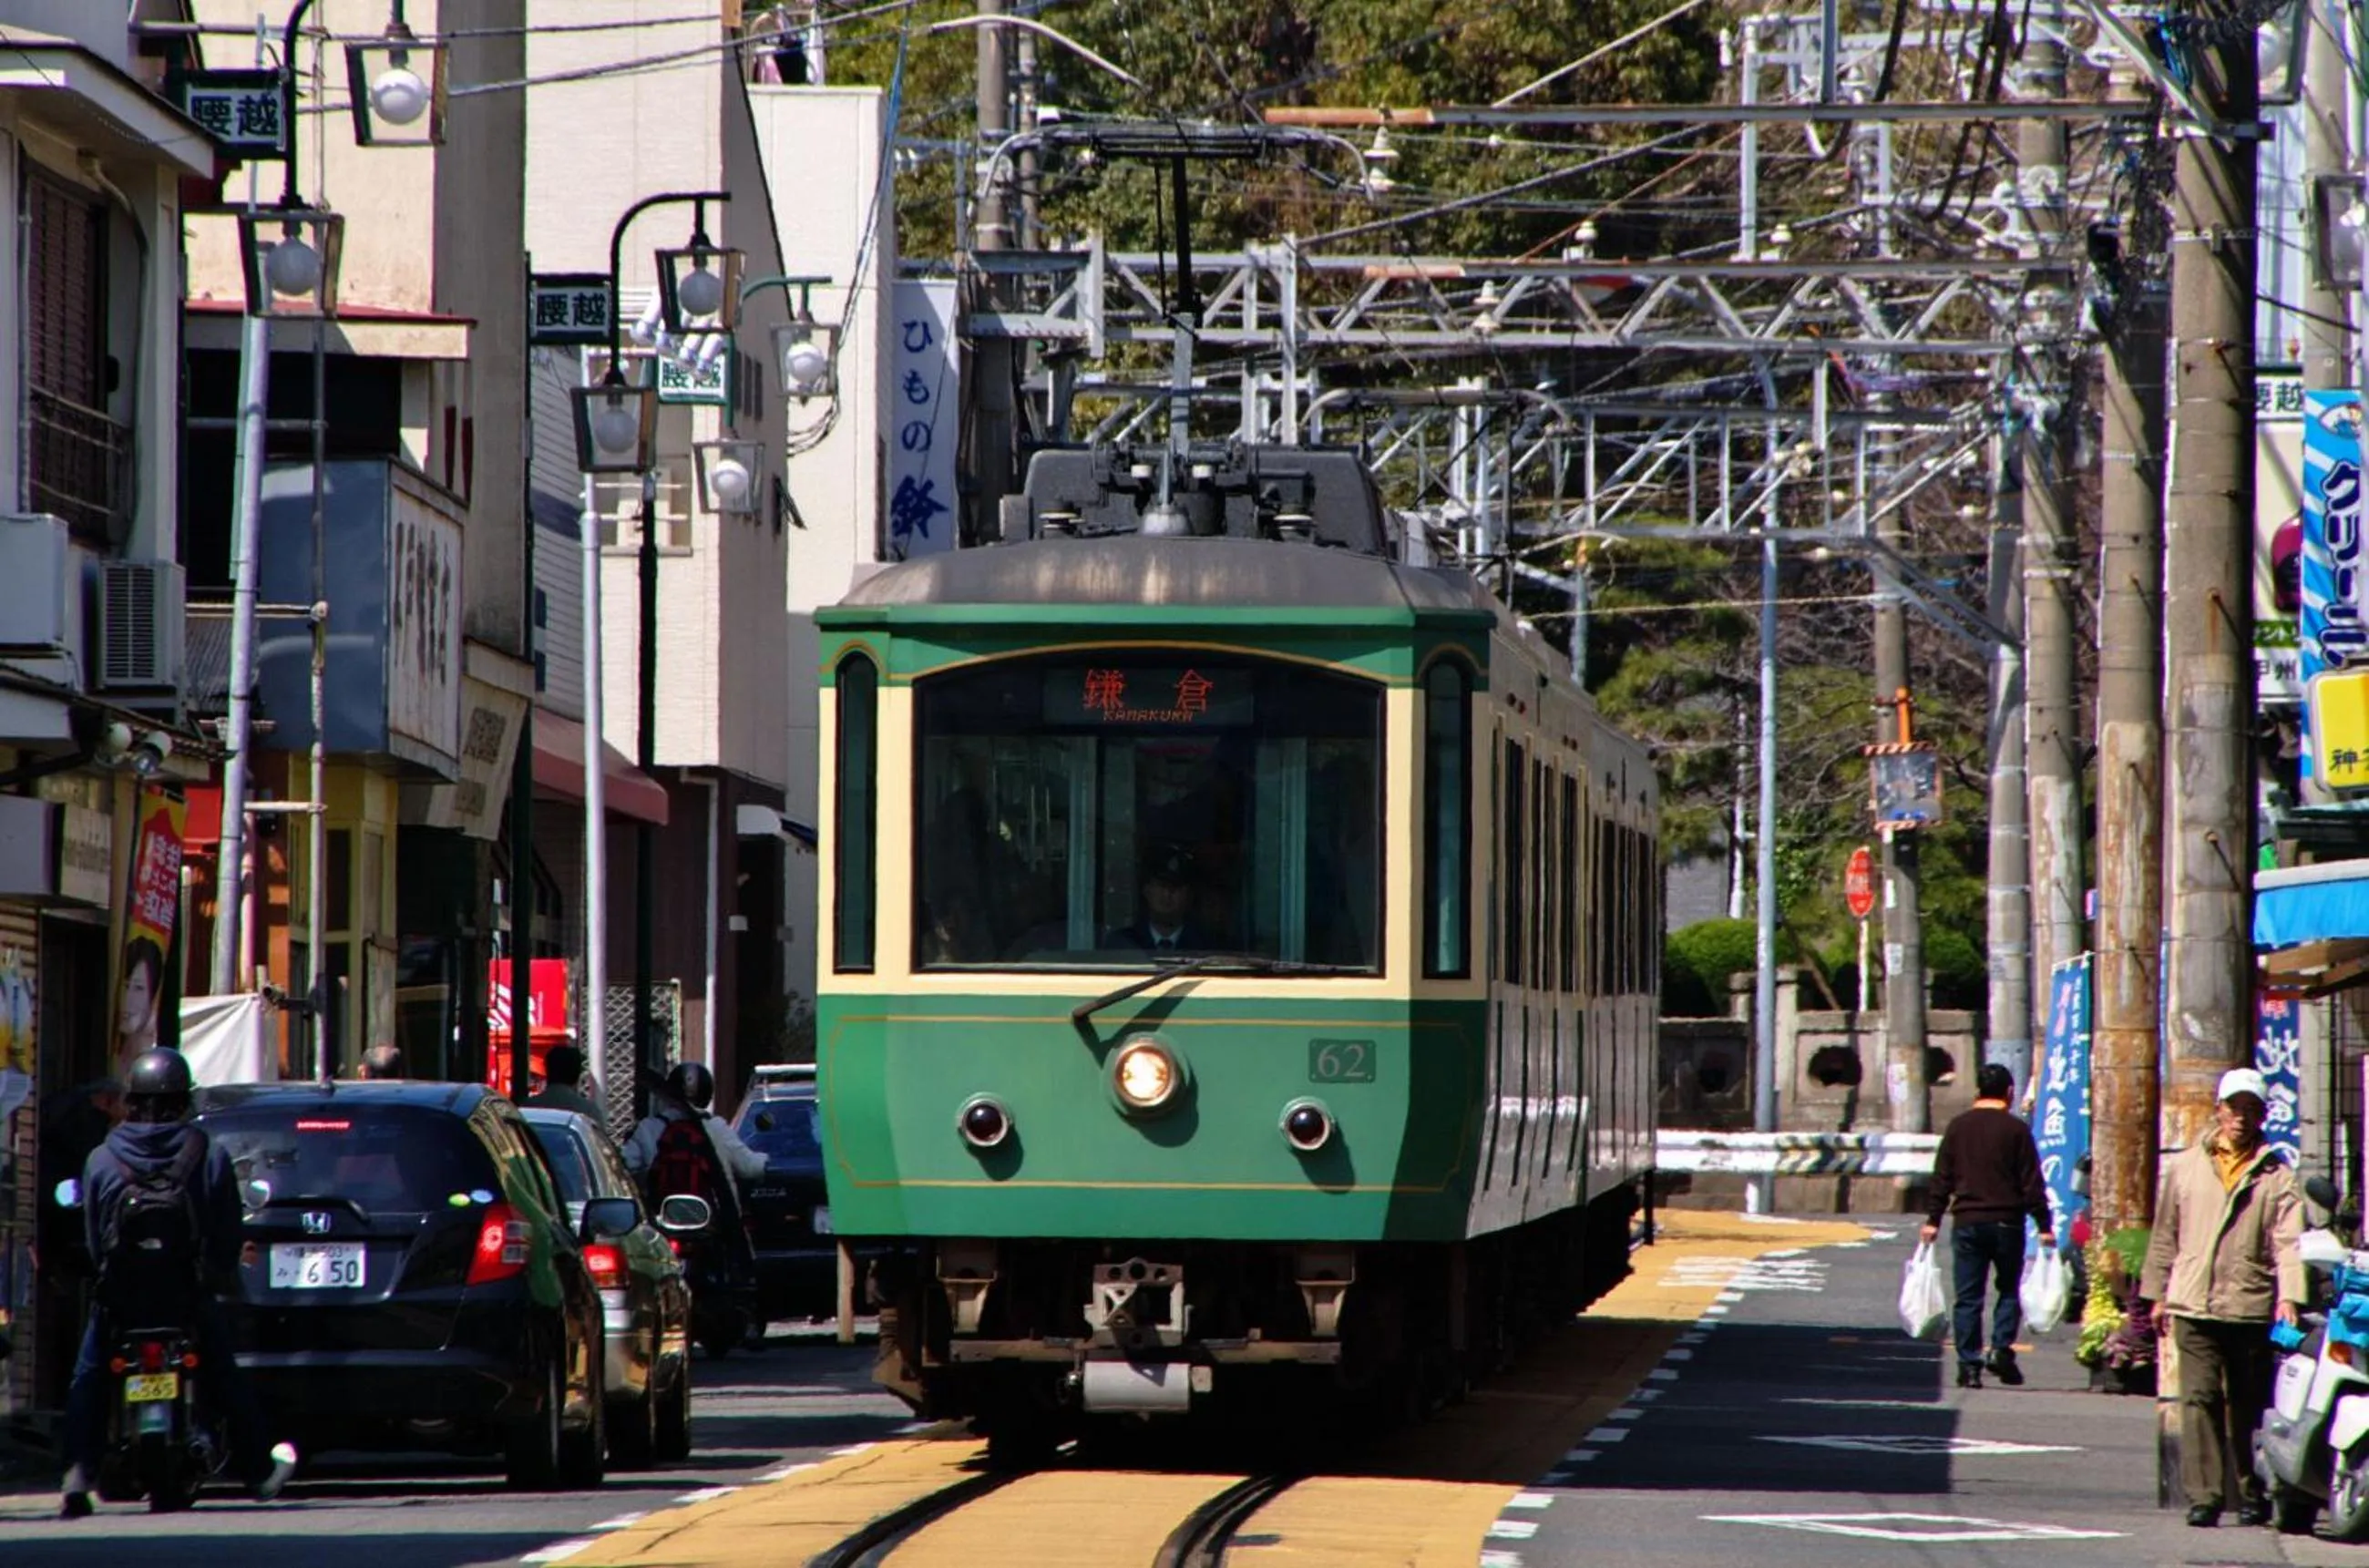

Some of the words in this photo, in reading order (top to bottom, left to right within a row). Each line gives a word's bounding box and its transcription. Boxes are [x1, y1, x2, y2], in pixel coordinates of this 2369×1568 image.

[190, 94, 278, 137] 腰越
[537, 292, 607, 327] 腰越
[1083, 669, 1214, 713] 鎌倉
[1103, 709, 1195, 723] KAMAKURA
[1318, 1044, 1367, 1078] 62
